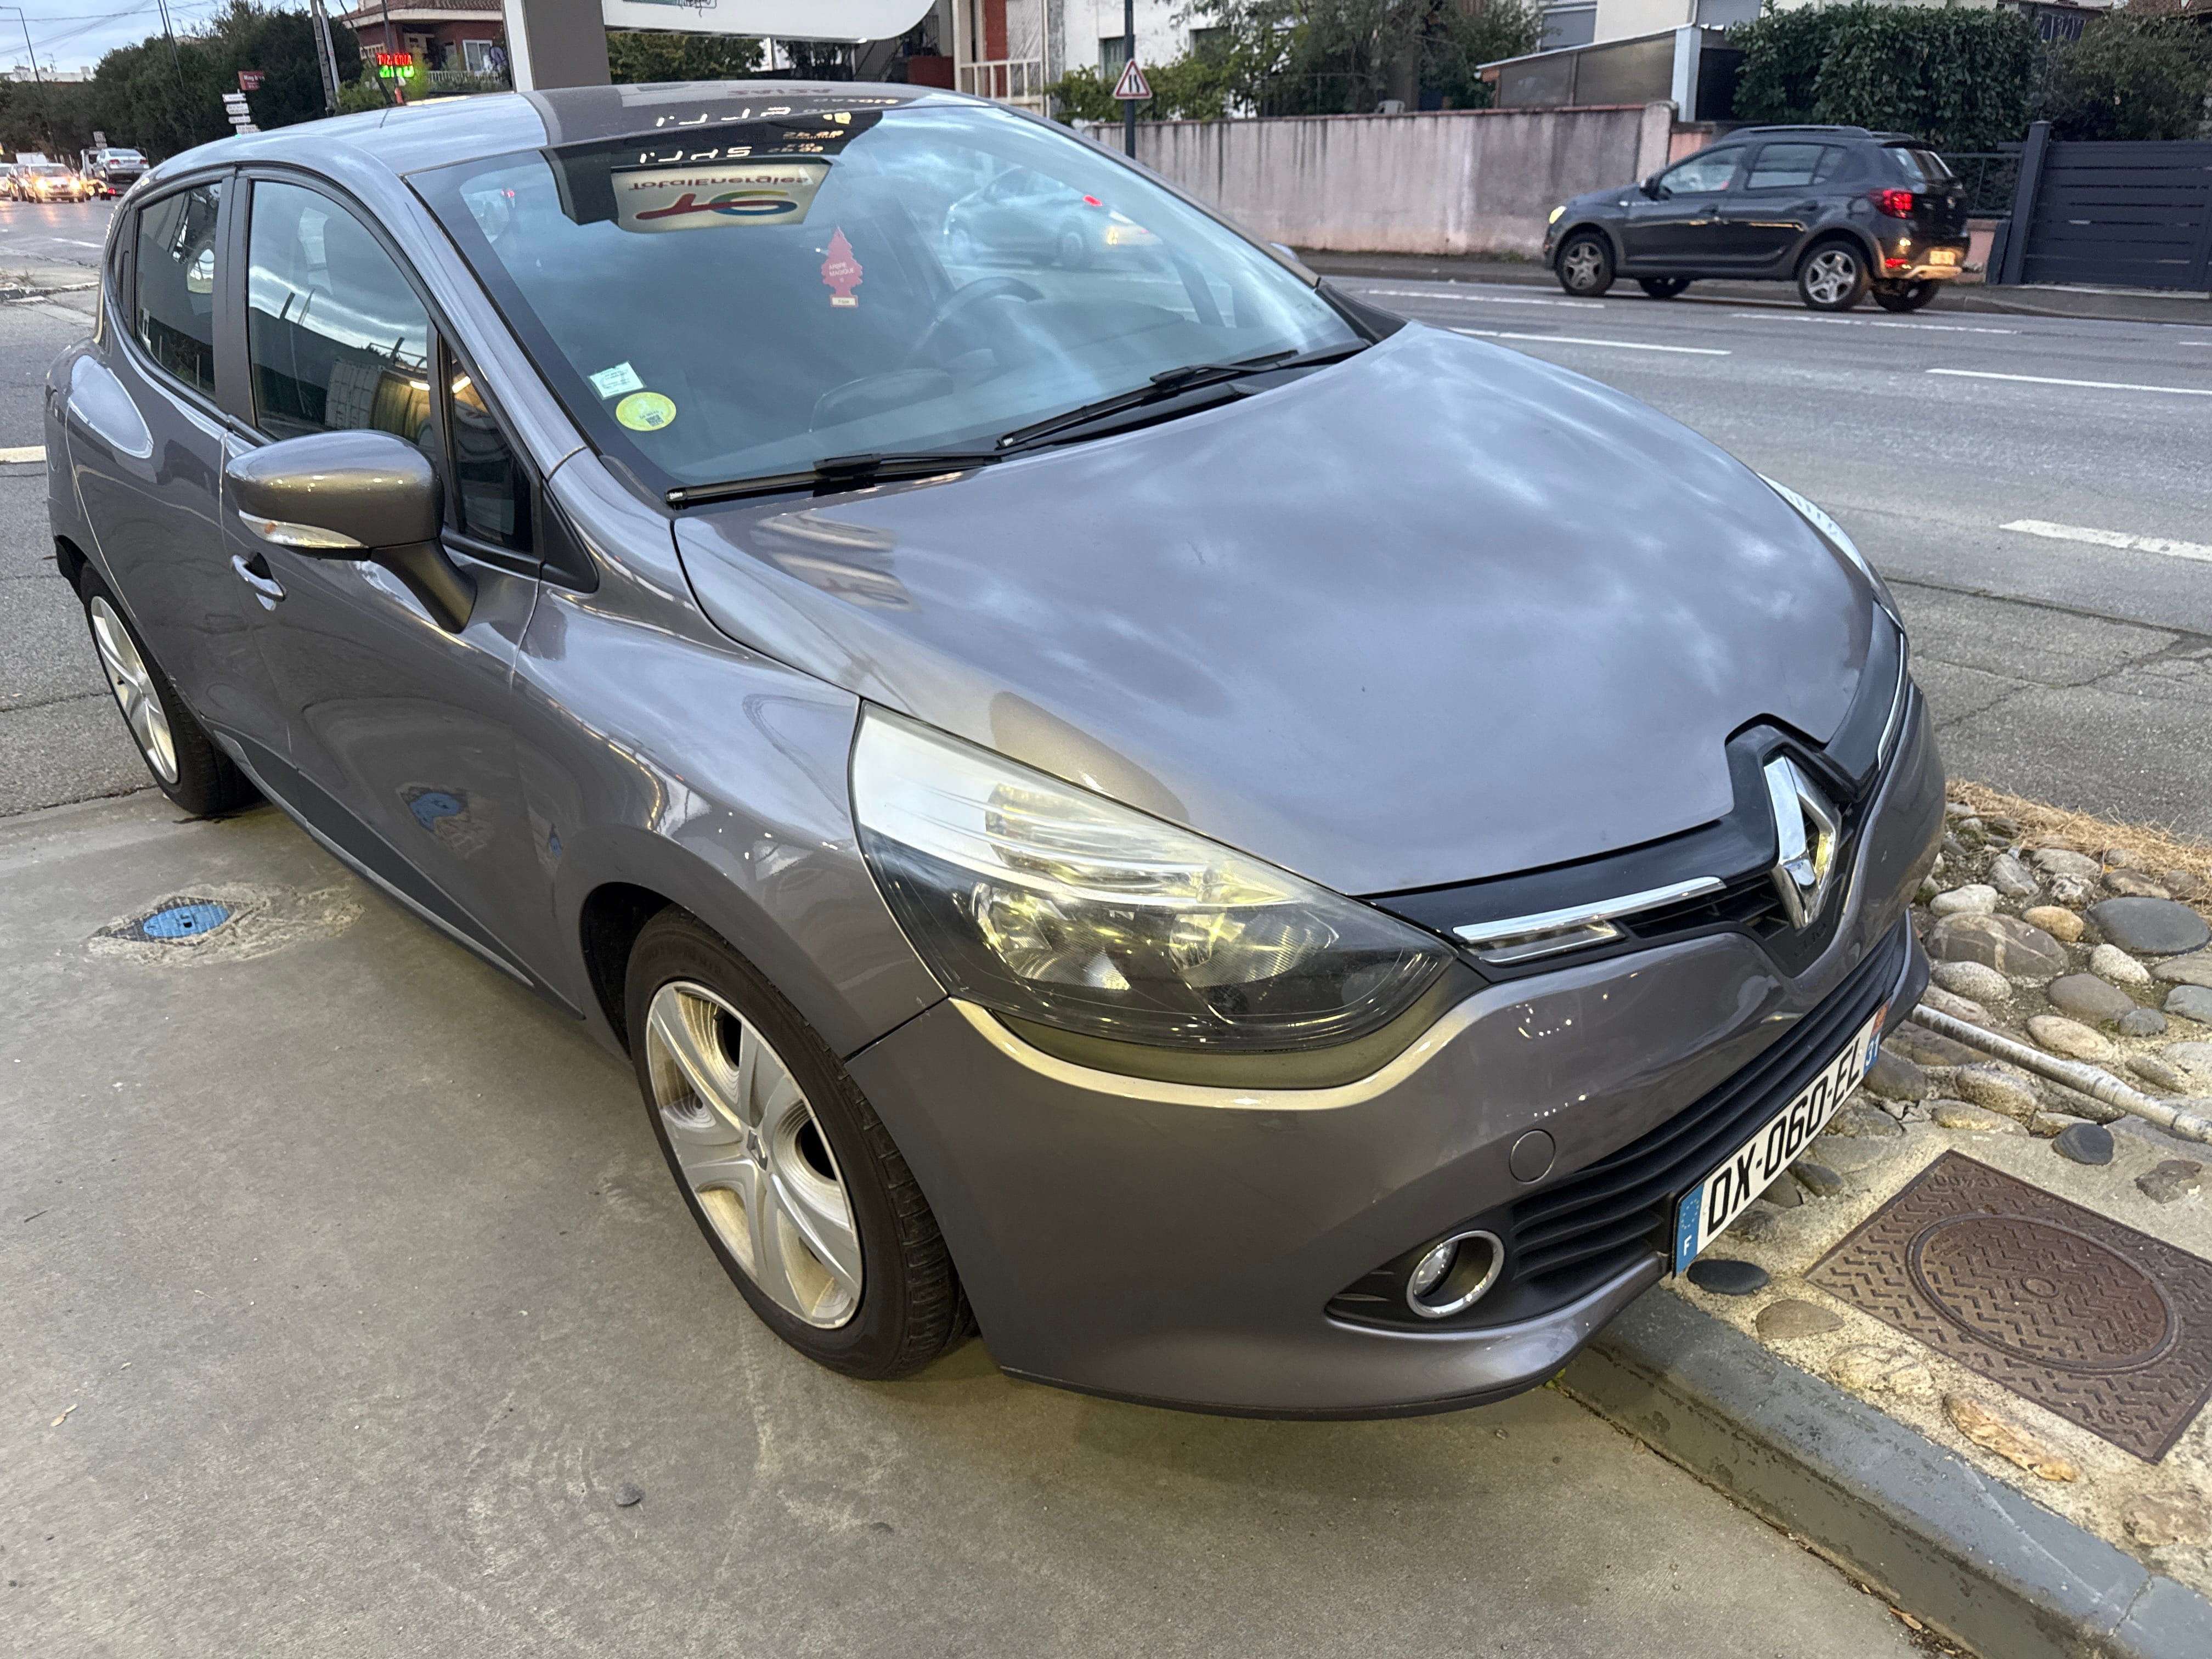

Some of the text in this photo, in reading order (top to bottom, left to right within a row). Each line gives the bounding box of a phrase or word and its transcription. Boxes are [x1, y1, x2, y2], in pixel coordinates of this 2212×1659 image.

[1865, 1032, 1881, 1066] 31
[1707, 1036, 1861, 1238] DX-060-EL
[1683, 1234, 1692, 1257] F
